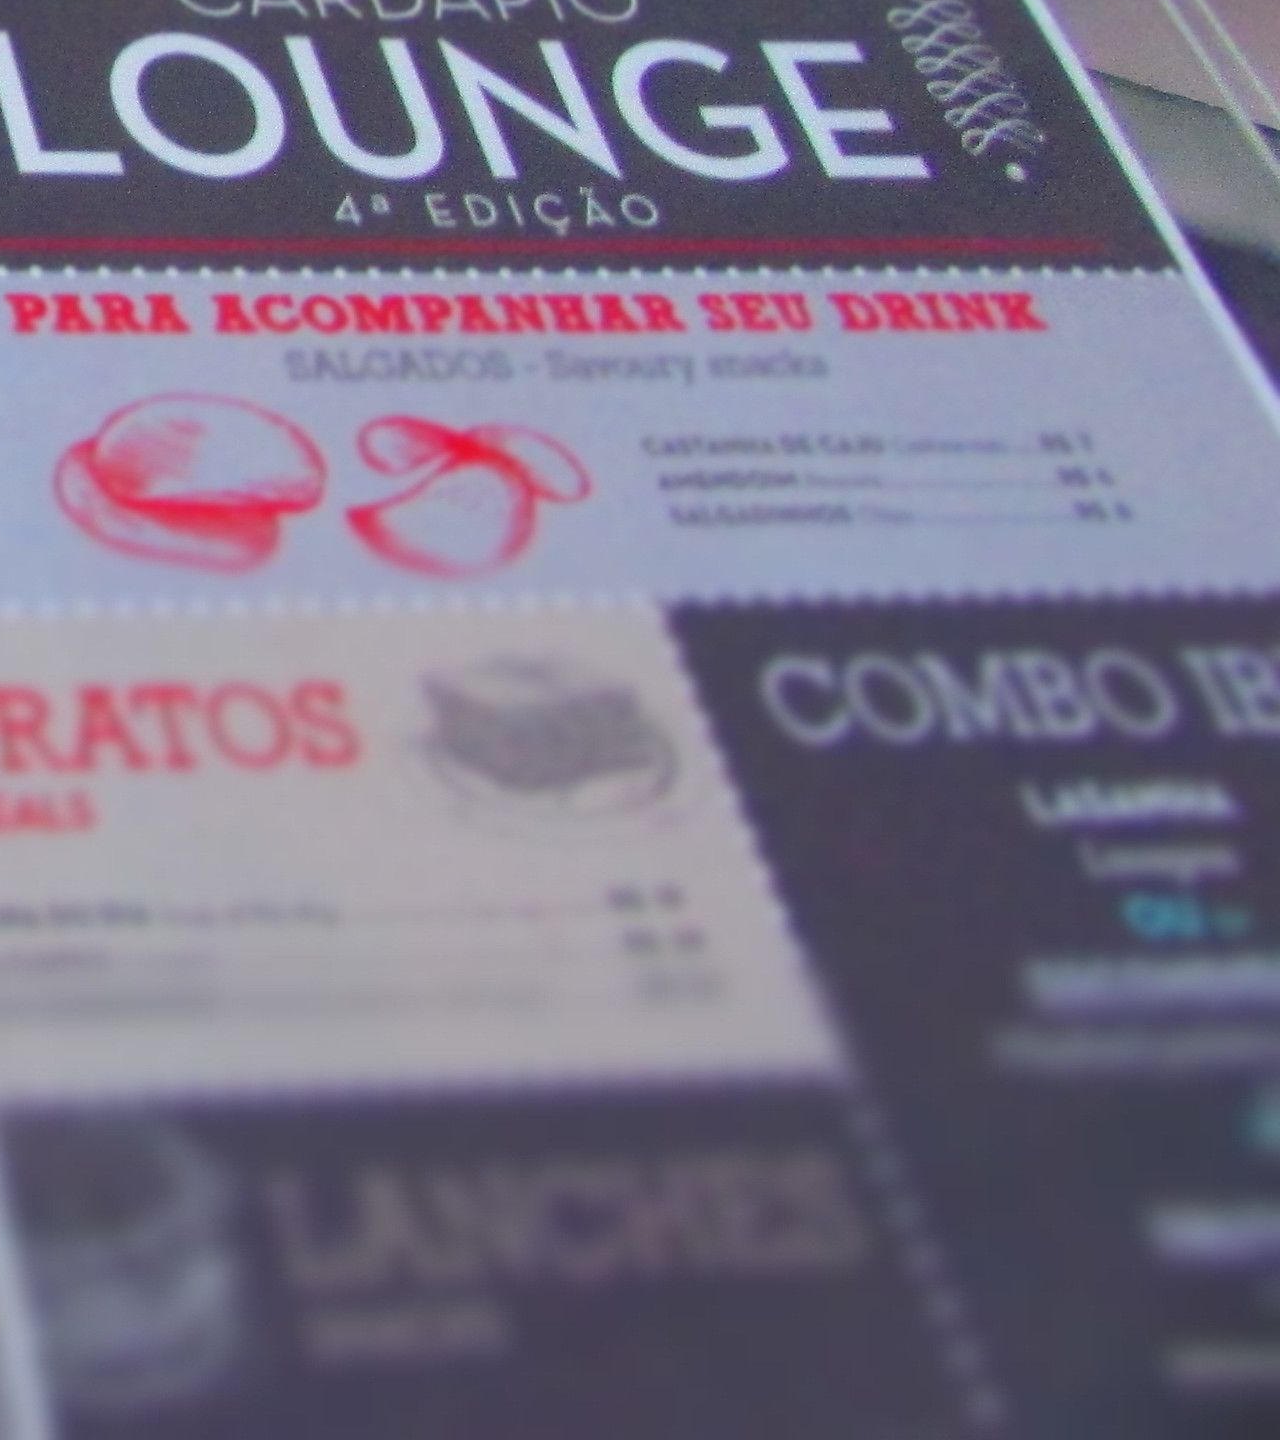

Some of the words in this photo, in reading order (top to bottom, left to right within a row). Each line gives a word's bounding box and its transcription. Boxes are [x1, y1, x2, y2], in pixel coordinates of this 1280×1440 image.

[427, 185, 662, 237] EDIÇÃO
[5, 293, 191, 336] PARA
[213, 292, 687, 336] ACOMPANHAR
[702, 291, 816, 333] SEU
[839, 291, 1048, 333] DRINK
[283, 347, 515, 383] SALGADOS
[757, 648, 1178, 747] COMBO
